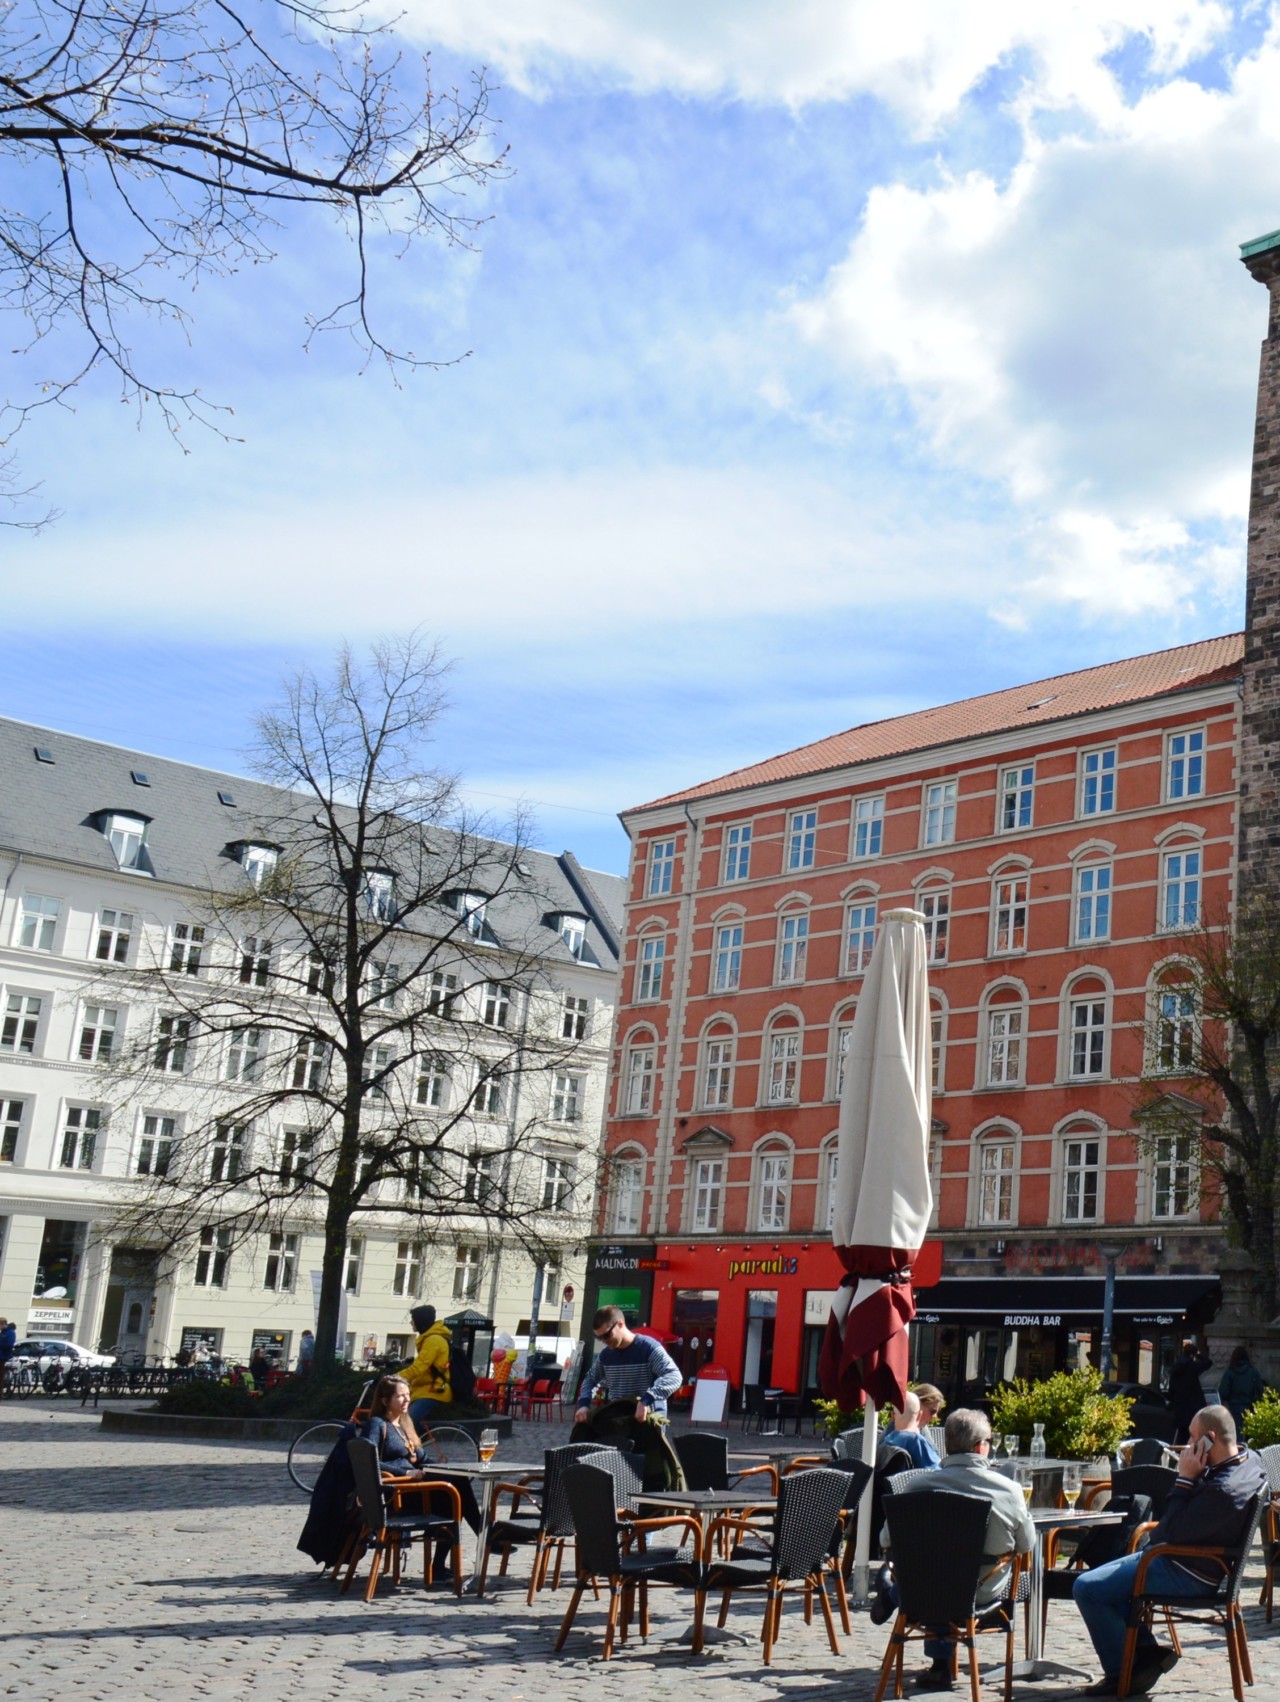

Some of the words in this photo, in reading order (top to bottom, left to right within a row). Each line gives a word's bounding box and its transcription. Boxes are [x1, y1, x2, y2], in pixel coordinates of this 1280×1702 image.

[728, 1255, 799, 1281] paradis
[34, 1311, 70, 1319] ZEPPELIN
[1004, 1316, 1040, 1326] BUDDHA
[1043, 1316, 1061, 1326] BAR
